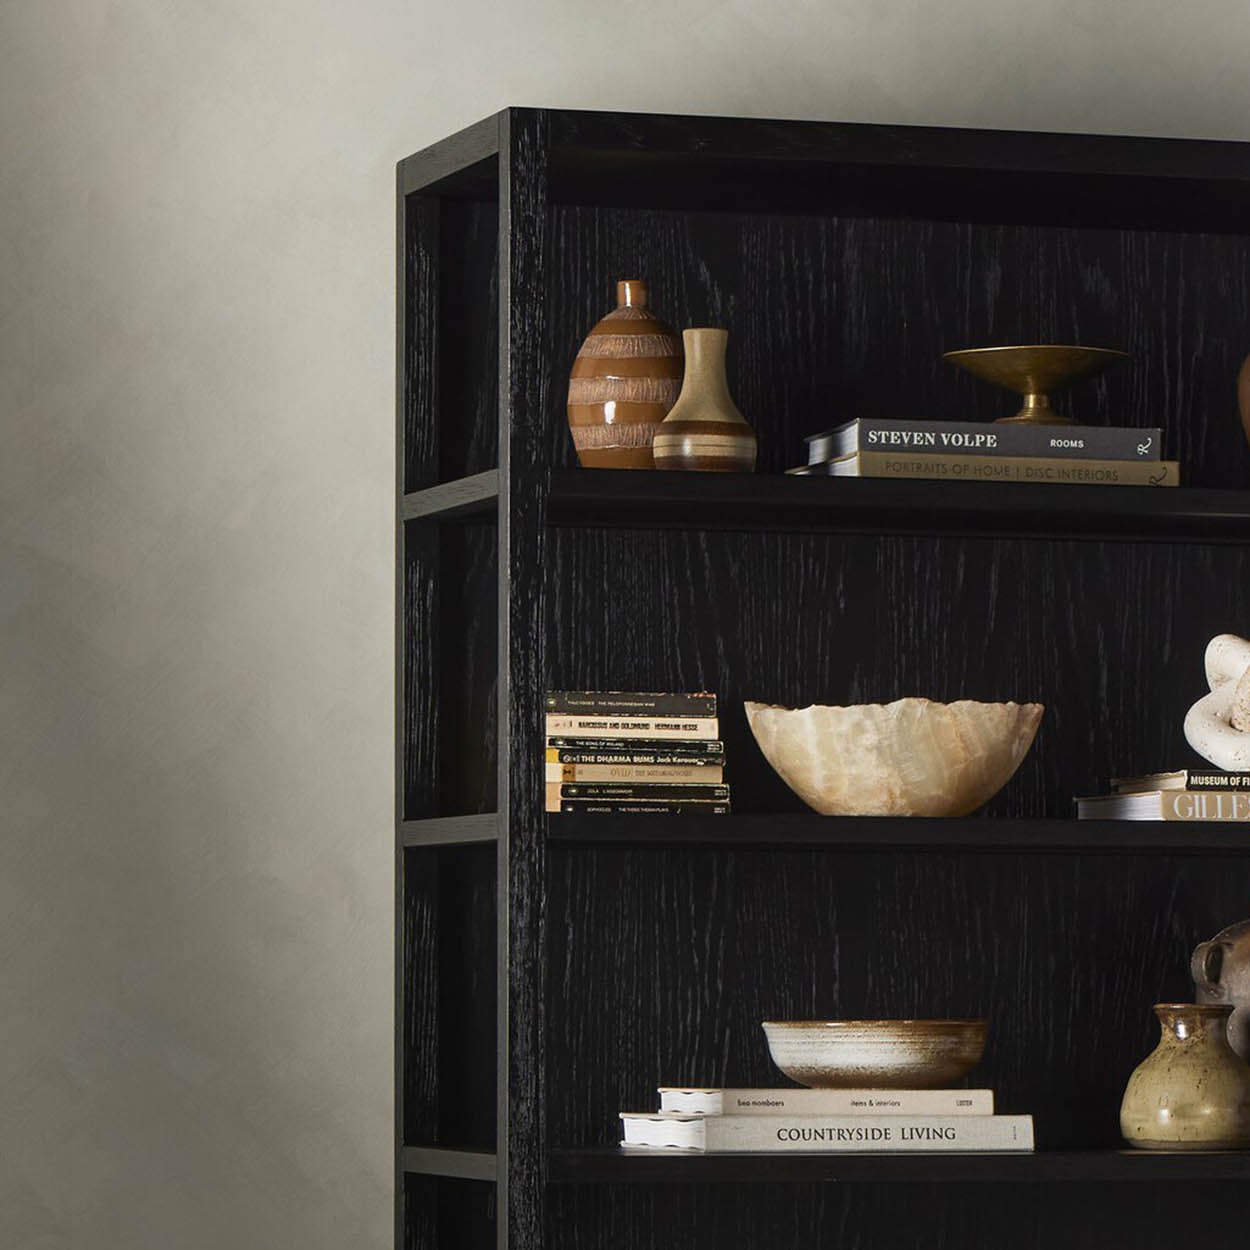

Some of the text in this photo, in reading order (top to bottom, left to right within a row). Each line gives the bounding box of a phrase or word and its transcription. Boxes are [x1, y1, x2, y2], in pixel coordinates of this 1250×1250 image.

[867, 430, 998, 448] STEVEN VOLPE
[1049, 438, 1085, 449] ROOMS
[885, 461, 1119, 482] PORTRAITS OF HOME DISC INTERIORS
[596, 755, 631, 763] DHARMA
[1190, 775, 1229, 787] MUSEUM
[1230, 776, 1241, 787] OF
[737, 1099, 785, 1107] bea mombaers
[776, 1127, 956, 1143] COUNTRYSIDE LIVING
